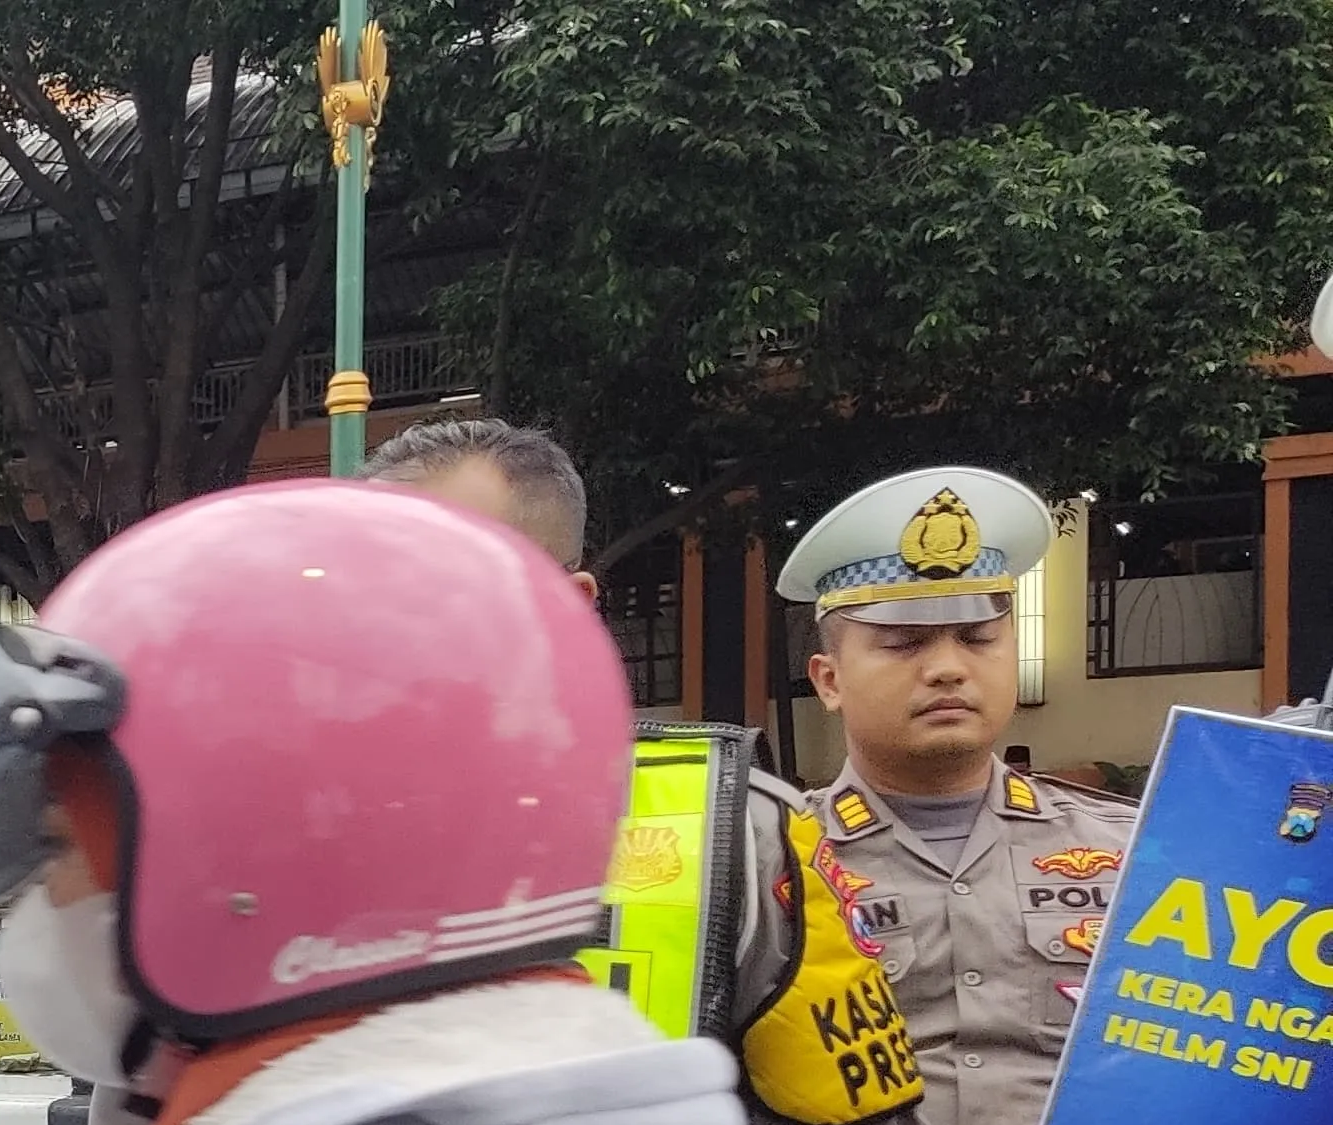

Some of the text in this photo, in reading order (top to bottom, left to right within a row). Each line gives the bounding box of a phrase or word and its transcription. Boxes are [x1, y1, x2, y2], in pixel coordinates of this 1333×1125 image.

[1028, 886, 1109, 909] POL
[1117, 968, 1234, 1023] KERA
[1103, 1014, 1313, 1091] HELM SNI
